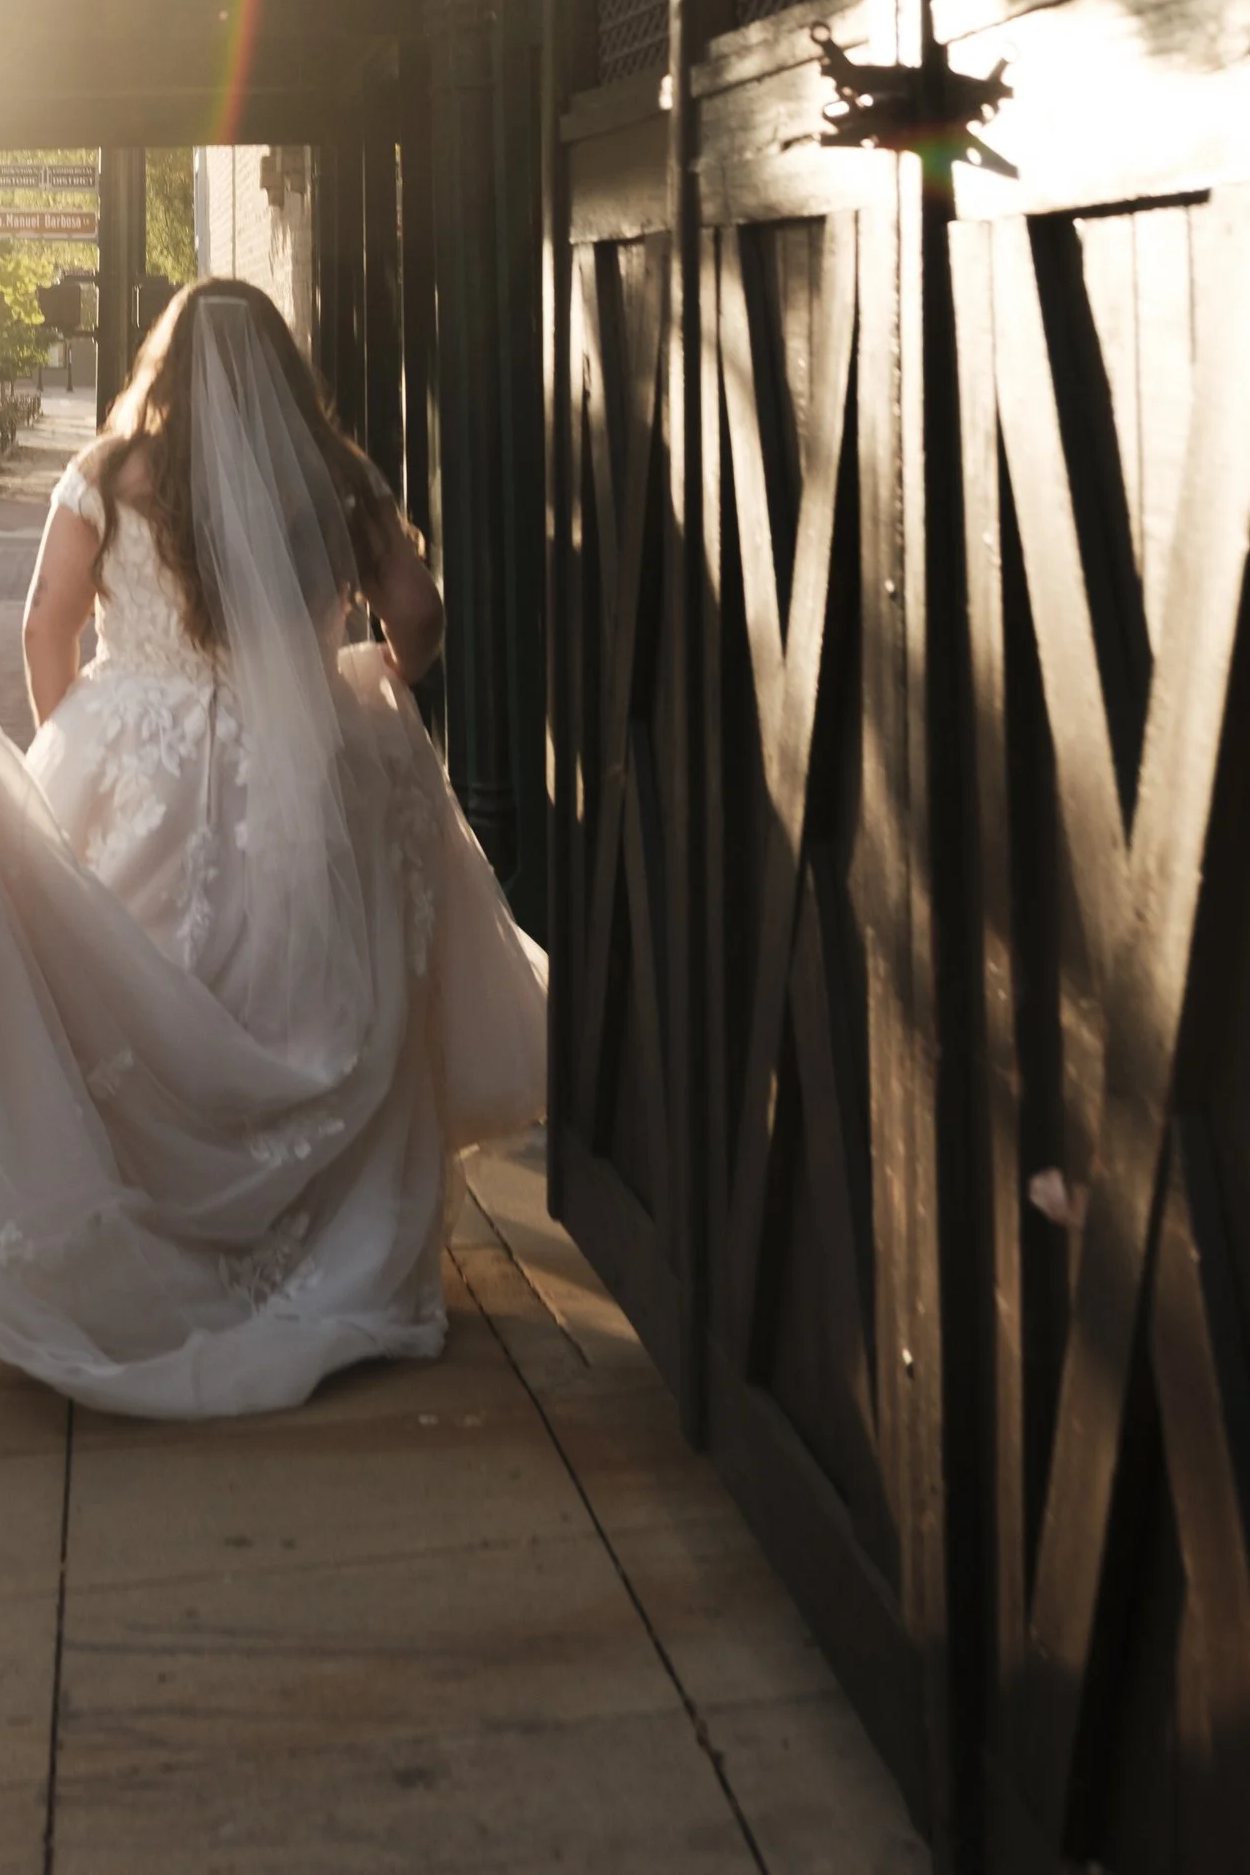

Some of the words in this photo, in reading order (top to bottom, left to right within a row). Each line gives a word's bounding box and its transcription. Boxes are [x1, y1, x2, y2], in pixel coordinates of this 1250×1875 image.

[51, 176, 94, 186] DISTRICT
[6, 213, 40, 228] Manuel
[44, 213, 82, 229] Barbosa
